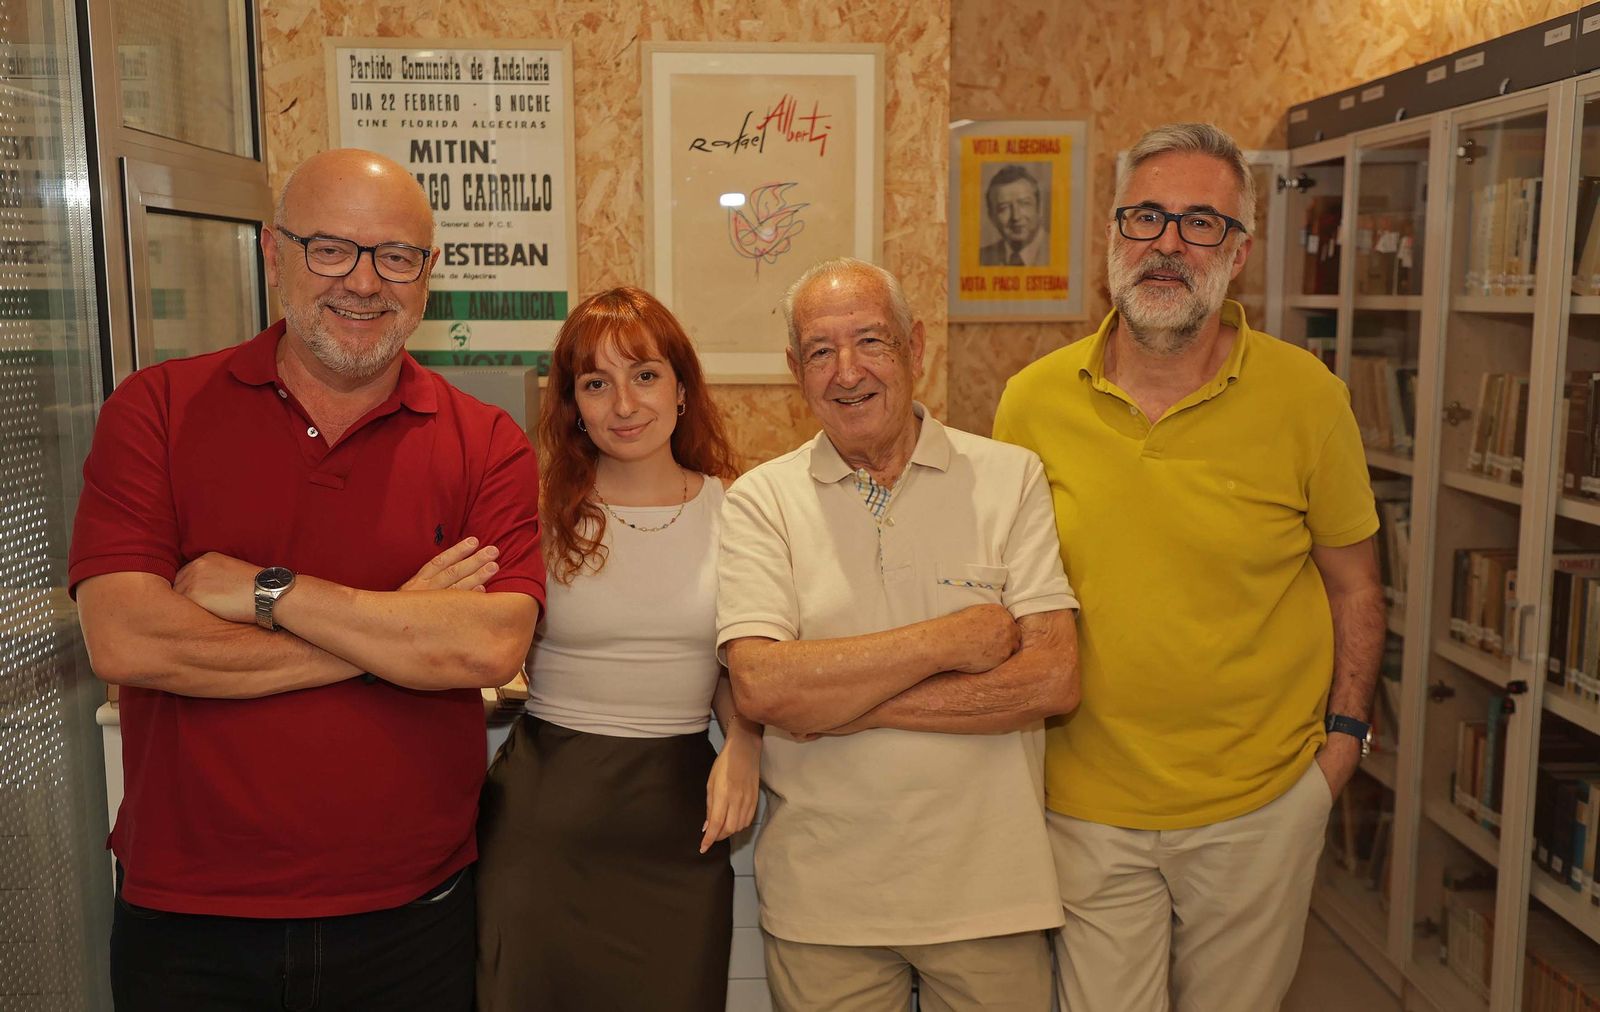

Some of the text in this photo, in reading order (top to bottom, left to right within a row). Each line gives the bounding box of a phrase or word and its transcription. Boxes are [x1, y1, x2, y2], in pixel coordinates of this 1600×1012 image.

[349, 54, 550, 81] Partido Comunista de Andalucía
[351, 92, 373, 111] DIA
[381, 93, 396, 111] 22
[404, 94, 460, 111] FEBRERO
[495, 95, 502, 112] 9
[510, 95, 551, 112] NOCHE
[357, 119, 547, 129] CINE FLORIDA ALGECIRAS
[688, 93, 832, 157] Rafael Alberti
[409, 139, 497, 164] MITIN:
[972, 138, 1061, 154] VOTA ALGECIRAS
[463, 173, 552, 211] CARRILLO
[444, 242, 548, 266] ESTEBAN
[463, 272, 496, 280] Algeciras
[960, 275, 1068, 292] VOTA PACO ESTEBAN
[469, 291, 556, 320] ANDALUCIA
